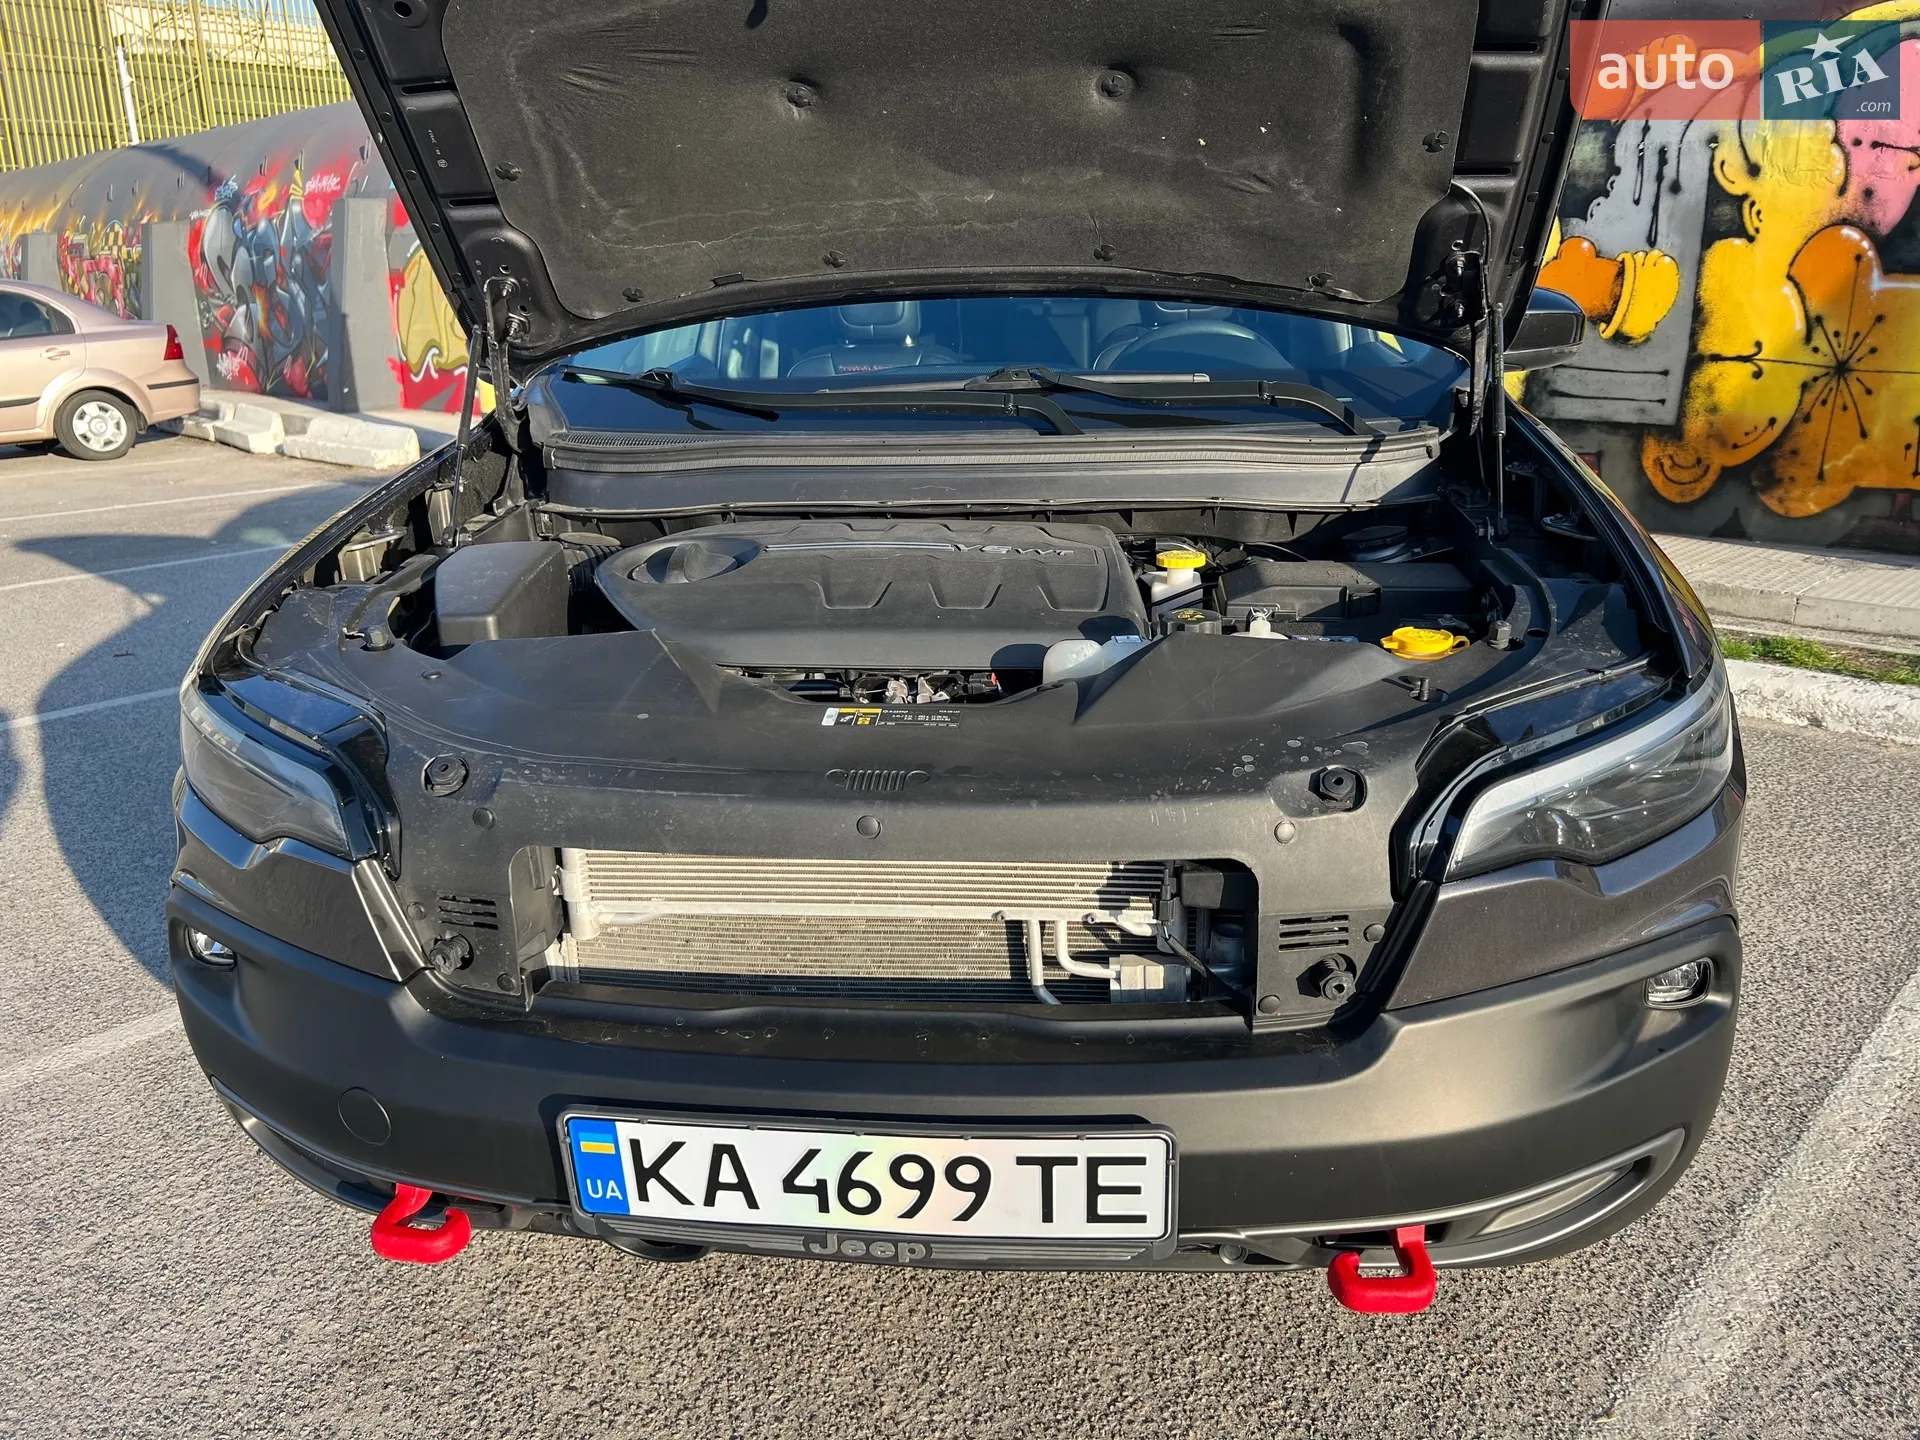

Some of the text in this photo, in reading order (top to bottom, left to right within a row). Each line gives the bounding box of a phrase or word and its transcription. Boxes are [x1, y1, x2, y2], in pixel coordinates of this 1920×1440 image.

[587, 1178, 623, 1200] UA
[629, 1138, 1147, 1223] KA 4699 TE
[809, 1232, 926, 1263] Jeep
